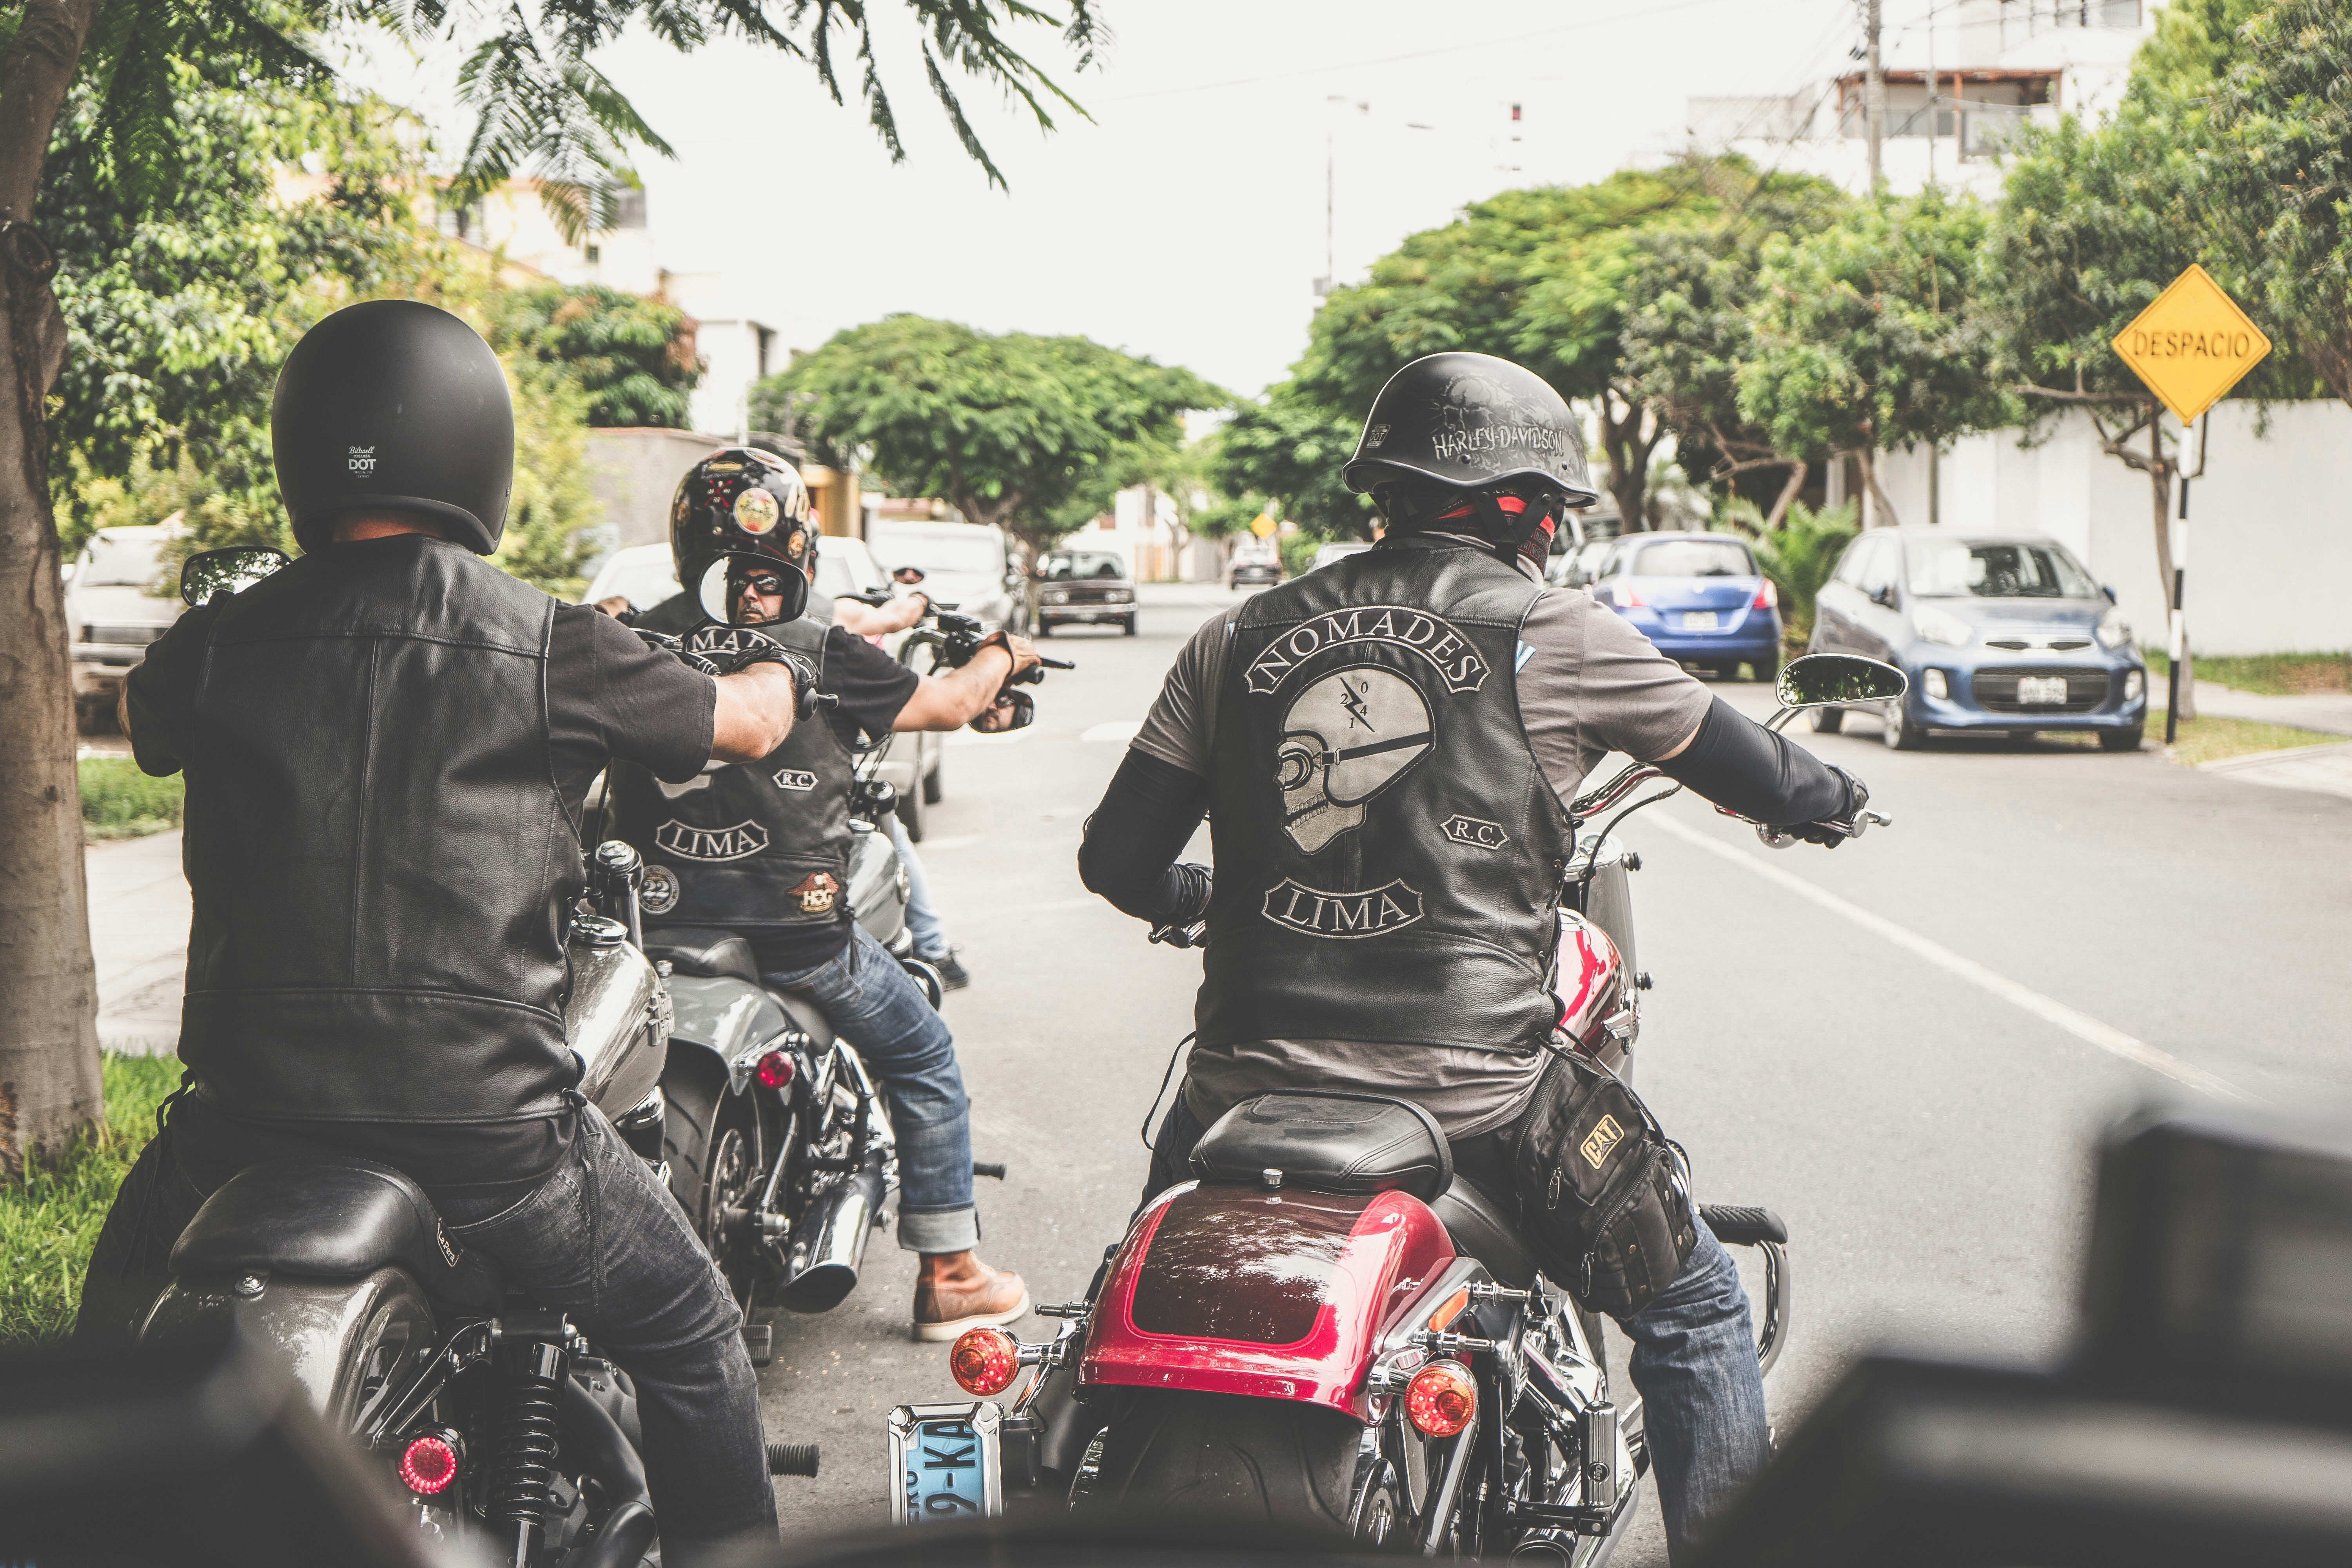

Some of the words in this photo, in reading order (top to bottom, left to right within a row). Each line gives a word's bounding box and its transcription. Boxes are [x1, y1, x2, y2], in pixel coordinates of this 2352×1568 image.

[2134, 330, 2250, 358] DESPACIO
[1369, 432, 1385, 441] DOT
[1432, 426, 1564, 460] HARLEY-DAVIDSON
[348, 459, 377, 470] DOT
[690, 629, 768, 652] MAD
[1254, 610, 1482, 683] NOMADES
[1340, 693, 1348, 704] 2
[1349, 717, 1355, 729] 1
[1359, 705, 1368, 716] 4
[669, 826, 760, 857] LIMA
[642, 880, 670, 898] 22
[1279, 888, 1411, 932] LIMA
[1585, 1119, 1618, 1163] CAT
[923, 1423, 978, 1515] 9-KA
